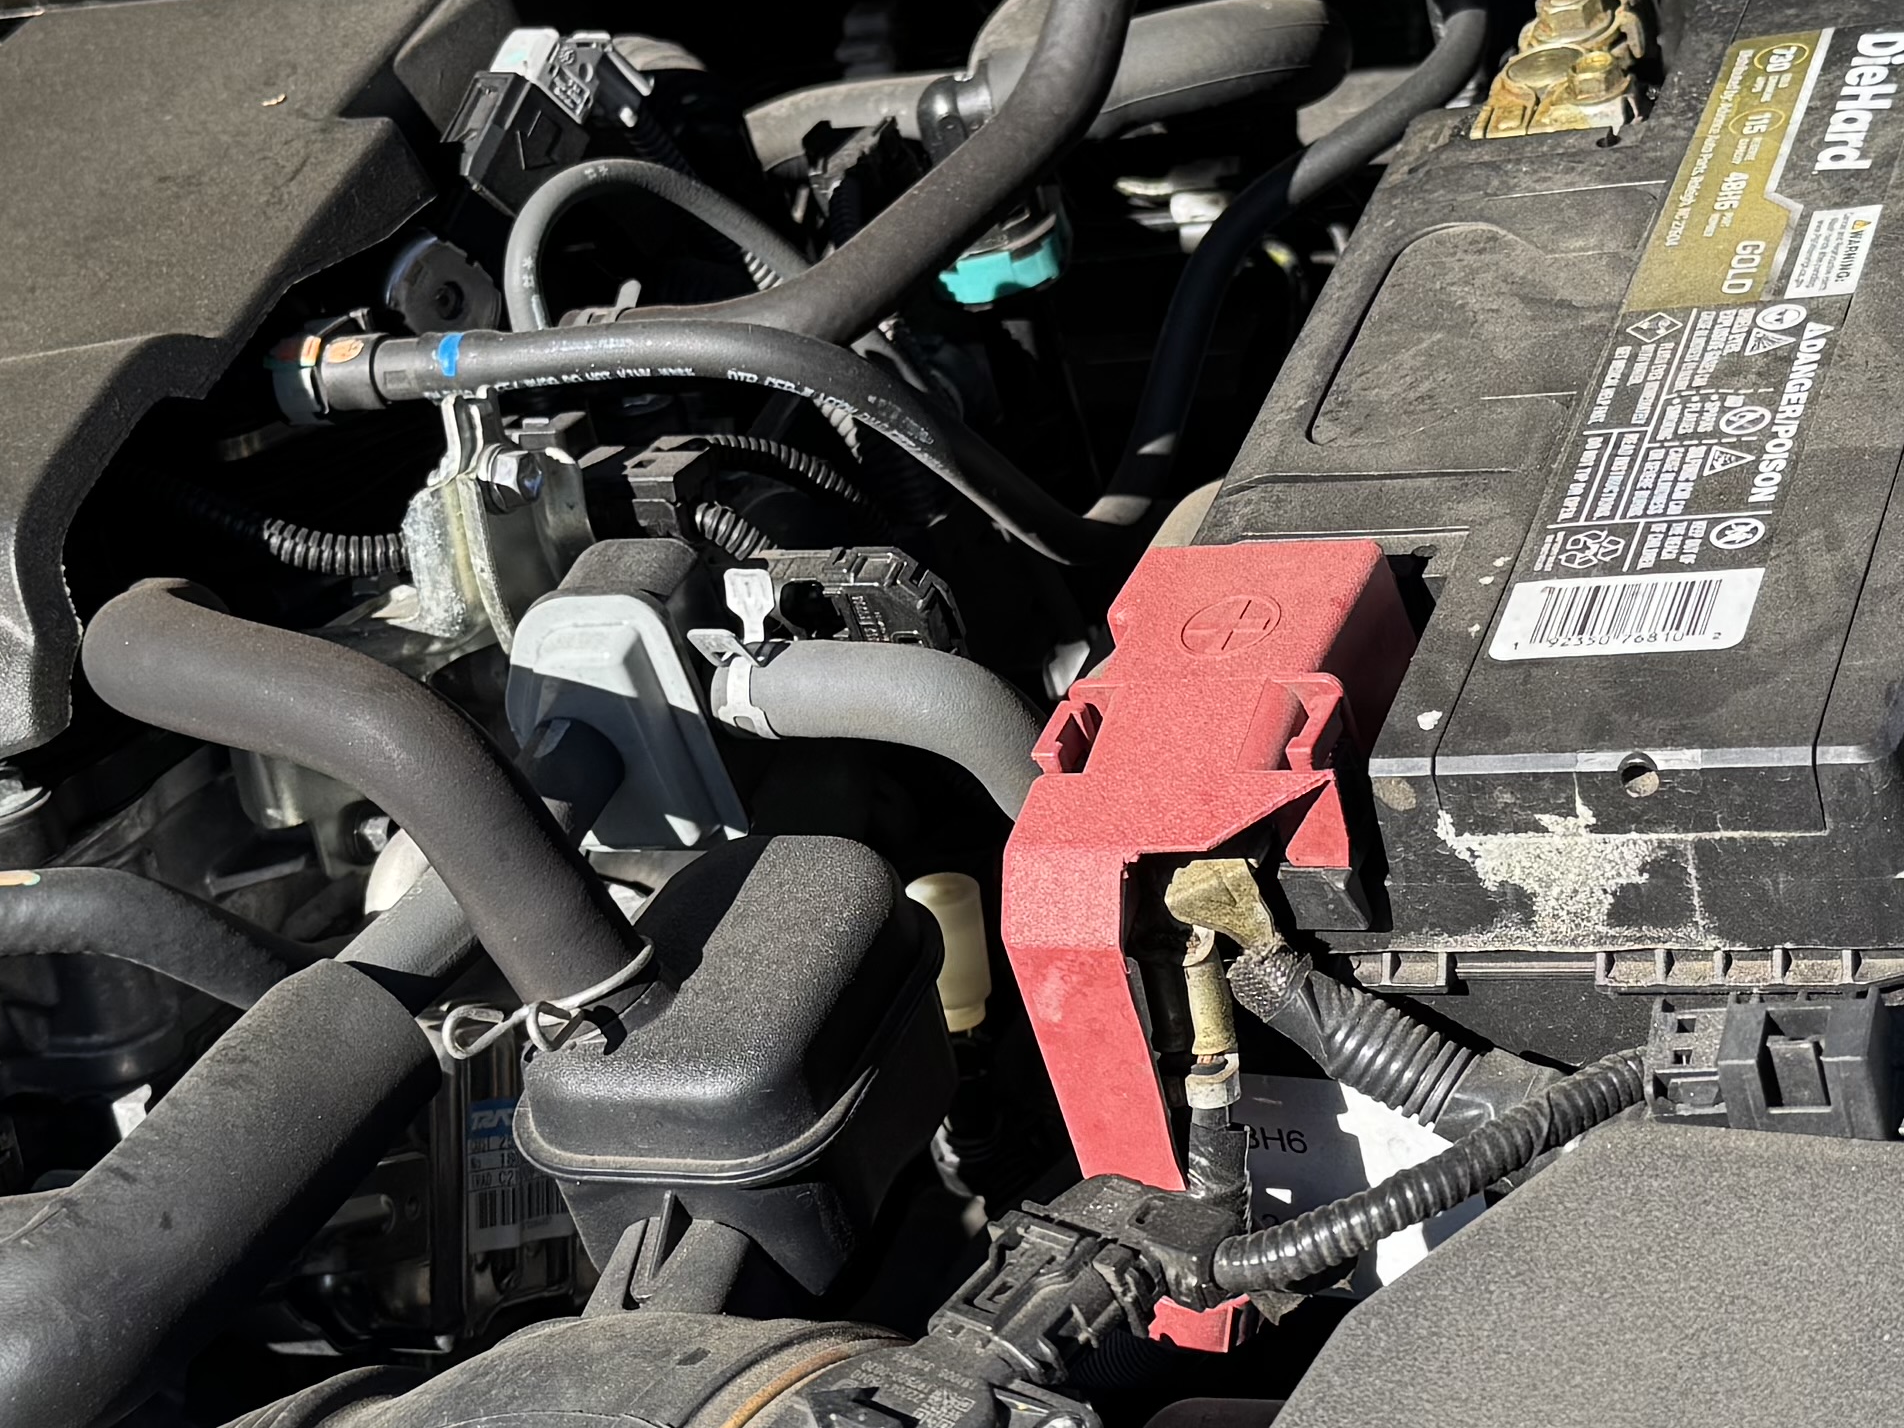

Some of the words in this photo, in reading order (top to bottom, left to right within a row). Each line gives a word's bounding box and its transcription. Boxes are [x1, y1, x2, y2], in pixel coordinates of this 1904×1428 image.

[1766, 46, 1797, 72] 730
[1708, 102, 1733, 134] Advance
[1742, 112, 1772, 135] 115
[1701, 134, 1721, 153] Auto
[1675, 207, 1692, 220] NC
[1722, 240, 1766, 294] GOLD
[1835, 230, 1864, 282] WARNING:
[1750, 338, 1825, 502] DANGER/POISON
